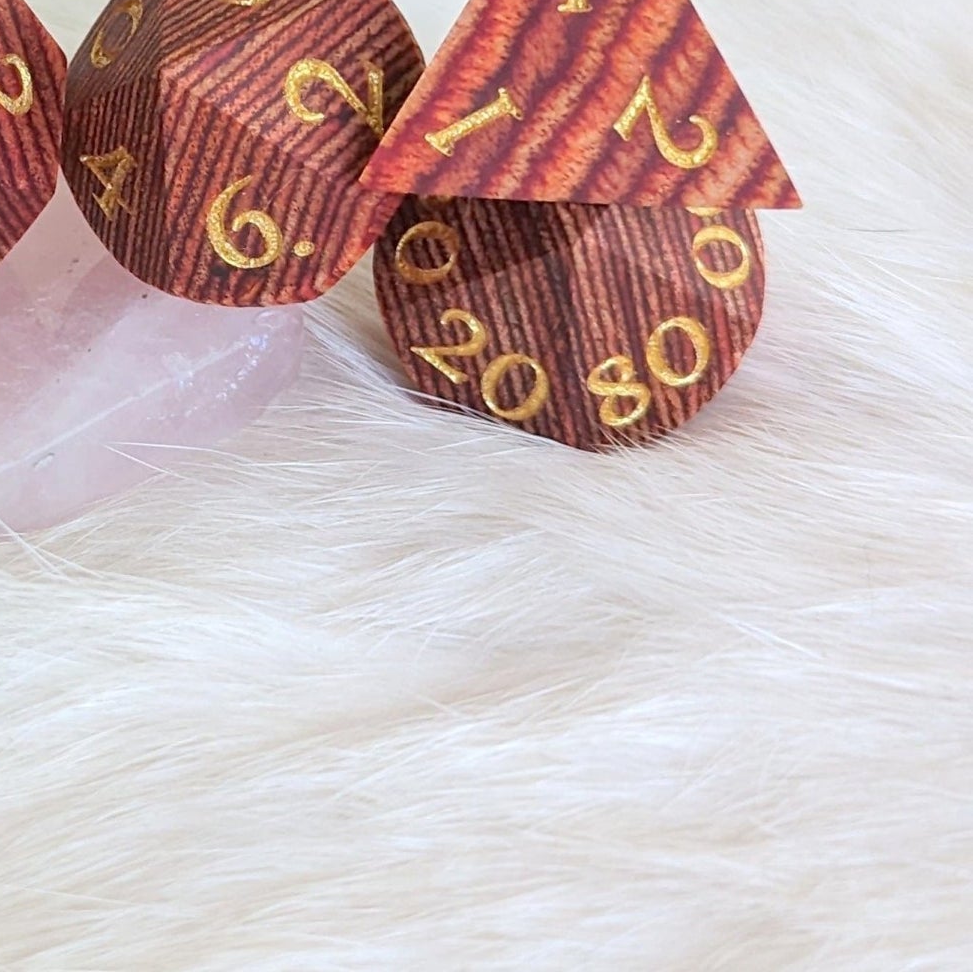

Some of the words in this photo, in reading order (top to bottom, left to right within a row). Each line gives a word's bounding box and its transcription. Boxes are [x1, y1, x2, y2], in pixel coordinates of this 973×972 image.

[284, 57, 385, 138] 2
[424, 87, 523, 158] 1
[612, 73, 719, 170] 2
[80, 145, 137, 222] 4
[410, 308, 551, 422] 20
[586, 315, 711, 428] 80
